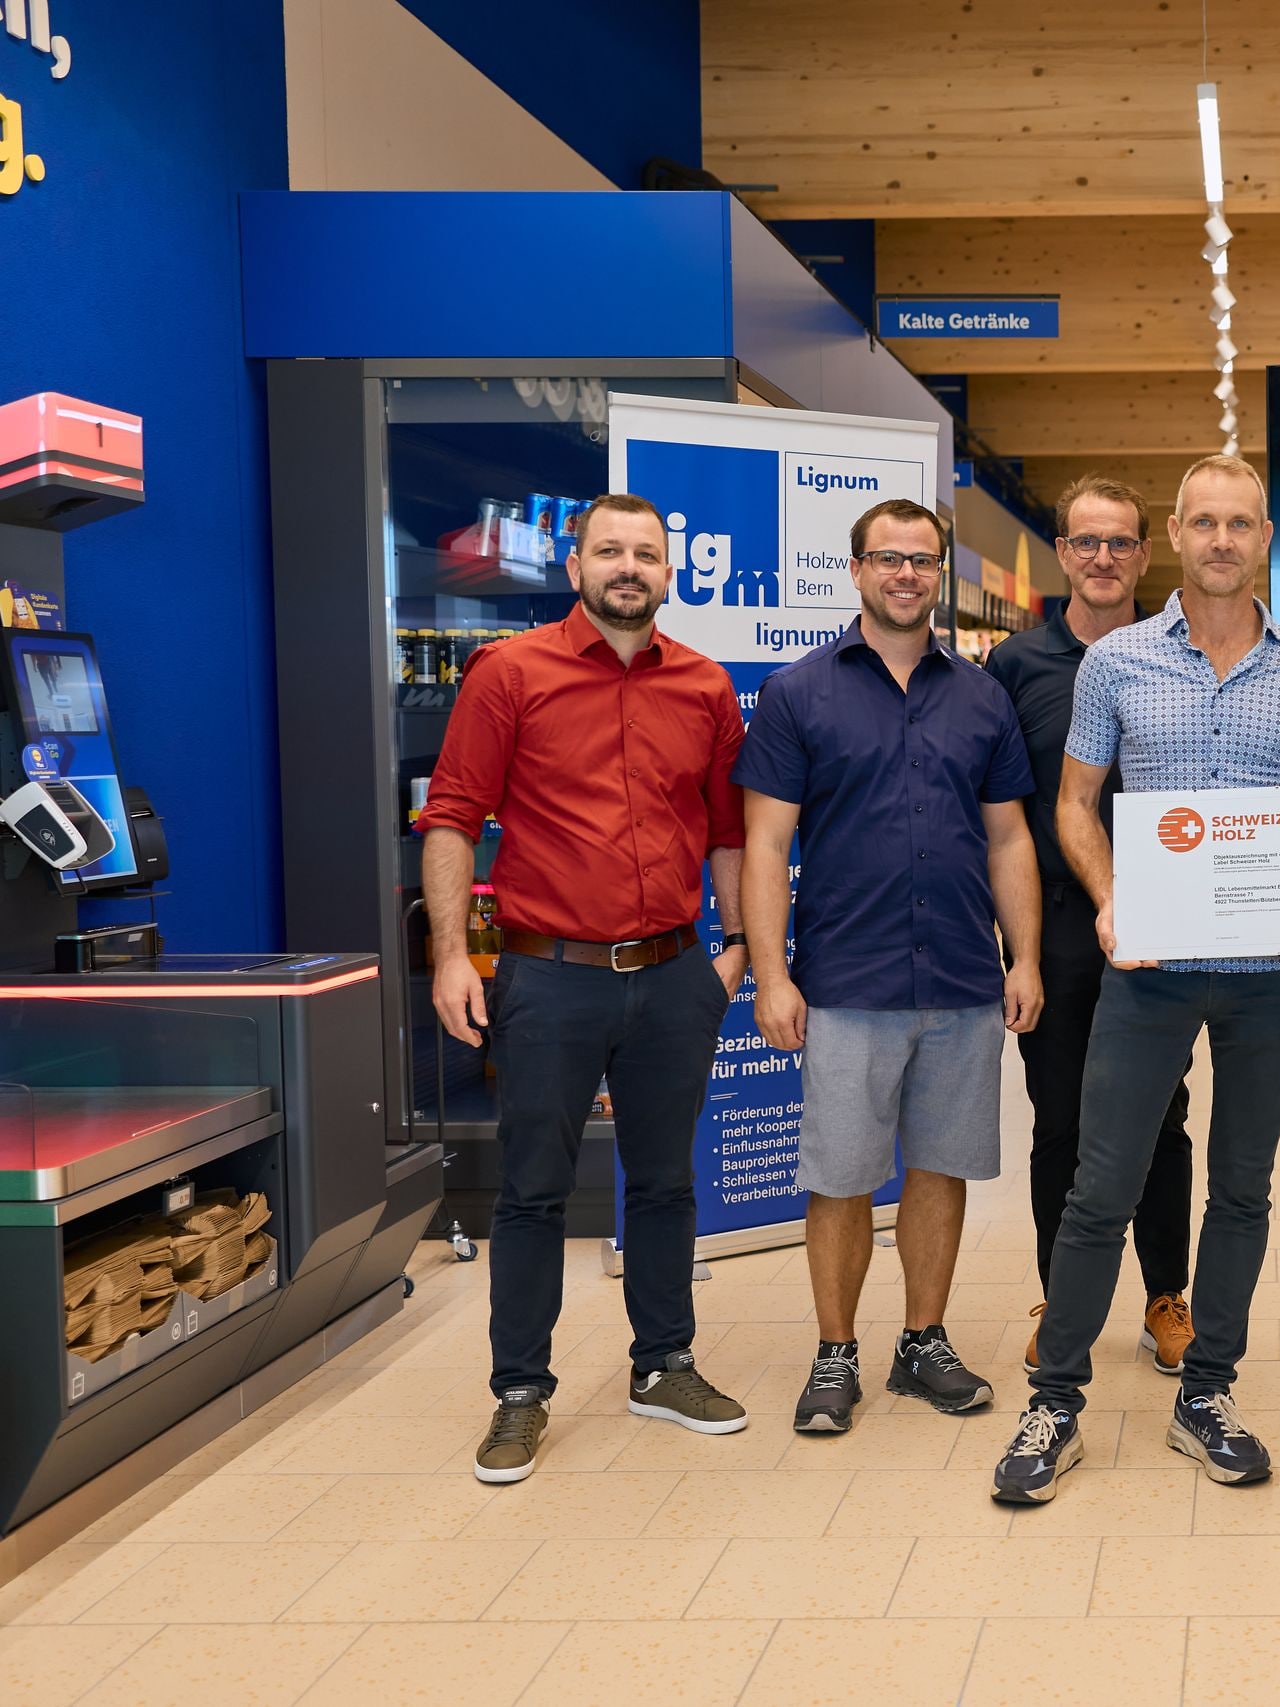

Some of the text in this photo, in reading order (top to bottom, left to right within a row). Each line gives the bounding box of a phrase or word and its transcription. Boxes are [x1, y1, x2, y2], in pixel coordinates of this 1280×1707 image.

[899, 313, 1030, 329] Kalte Getränke
[95, 422, 104, 448] 1
[797, 466, 879, 493] Lignum
[797, 552, 853, 570] Holzw
[797, 580, 833, 596] Bern
[1212, 829, 1256, 841] HOLZ
[712, 1061, 737, 1080] für
[742, 1055, 789, 1076] mehr
[722, 1105, 783, 1122] Förderung
[722, 1124, 753, 1139] mehr
[722, 1152, 800, 1171] Bauprojekten
[722, 1169, 786, 1188] Schliessen
[722, 1183, 807, 1204] Verarbeitungs
